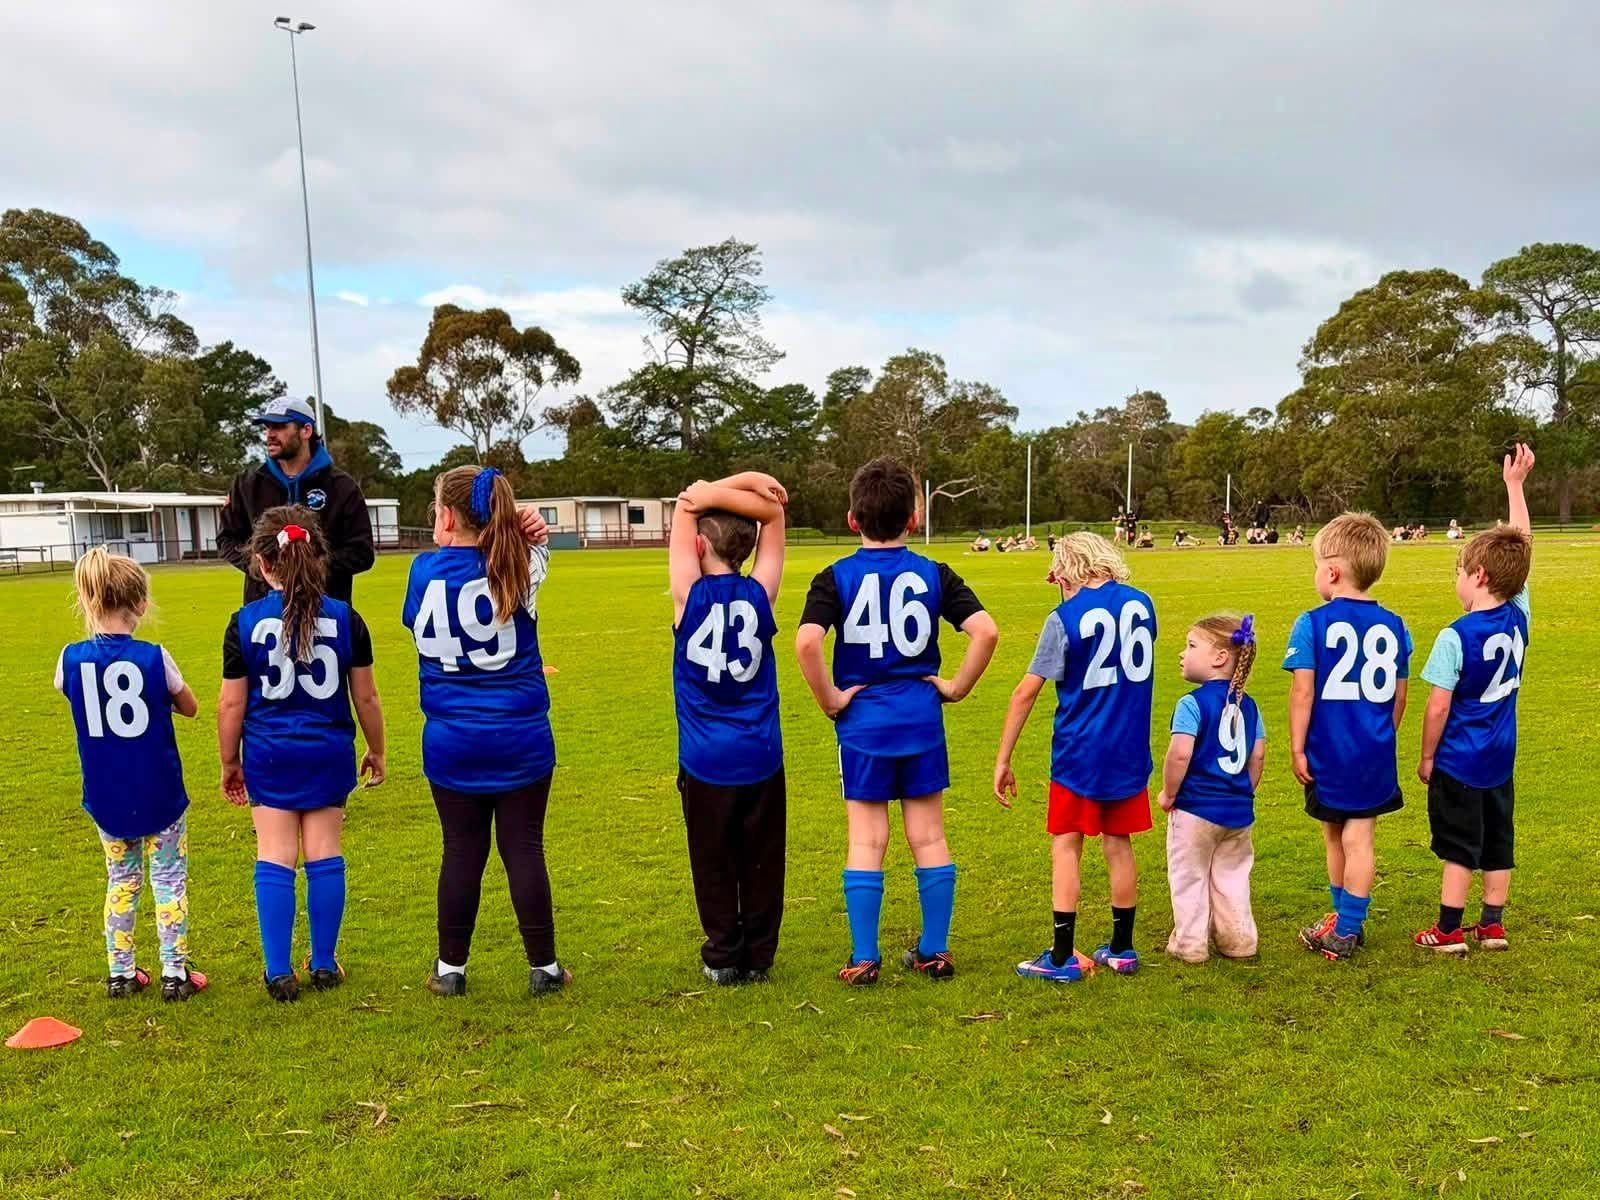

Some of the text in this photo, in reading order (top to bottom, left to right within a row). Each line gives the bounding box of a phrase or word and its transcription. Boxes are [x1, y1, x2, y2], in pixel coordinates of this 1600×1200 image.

[414, 578, 516, 671] 49
[687, 600, 762, 682] 43
[844, 572, 931, 658] 46
[1080, 600, 1152, 689] 26
[81, 661, 149, 737] 18
[251, 618, 339, 699] 35
[1322, 622, 1398, 702] 28
[1217, 703, 1246, 774] 9
